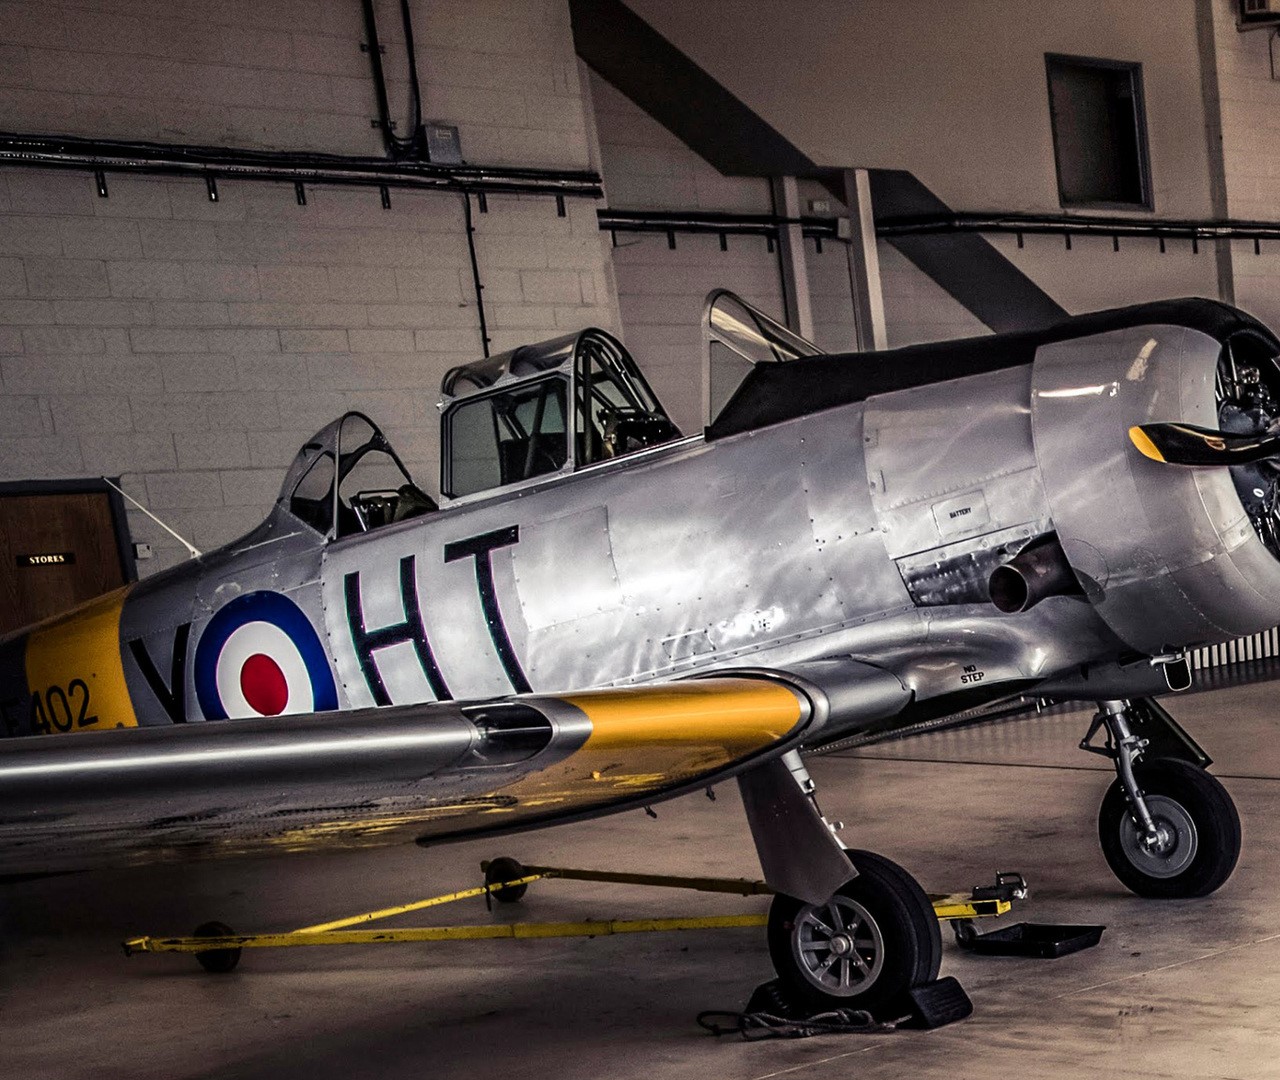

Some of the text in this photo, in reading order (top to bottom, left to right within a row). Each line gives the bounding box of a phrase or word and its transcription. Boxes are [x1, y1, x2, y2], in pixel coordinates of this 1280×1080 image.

[949, 507, 971, 519] BATTERY
[29, 555, 65, 564] STORES
[963, 664, 977, 673] NO
[960, 671, 985, 684] STEP
